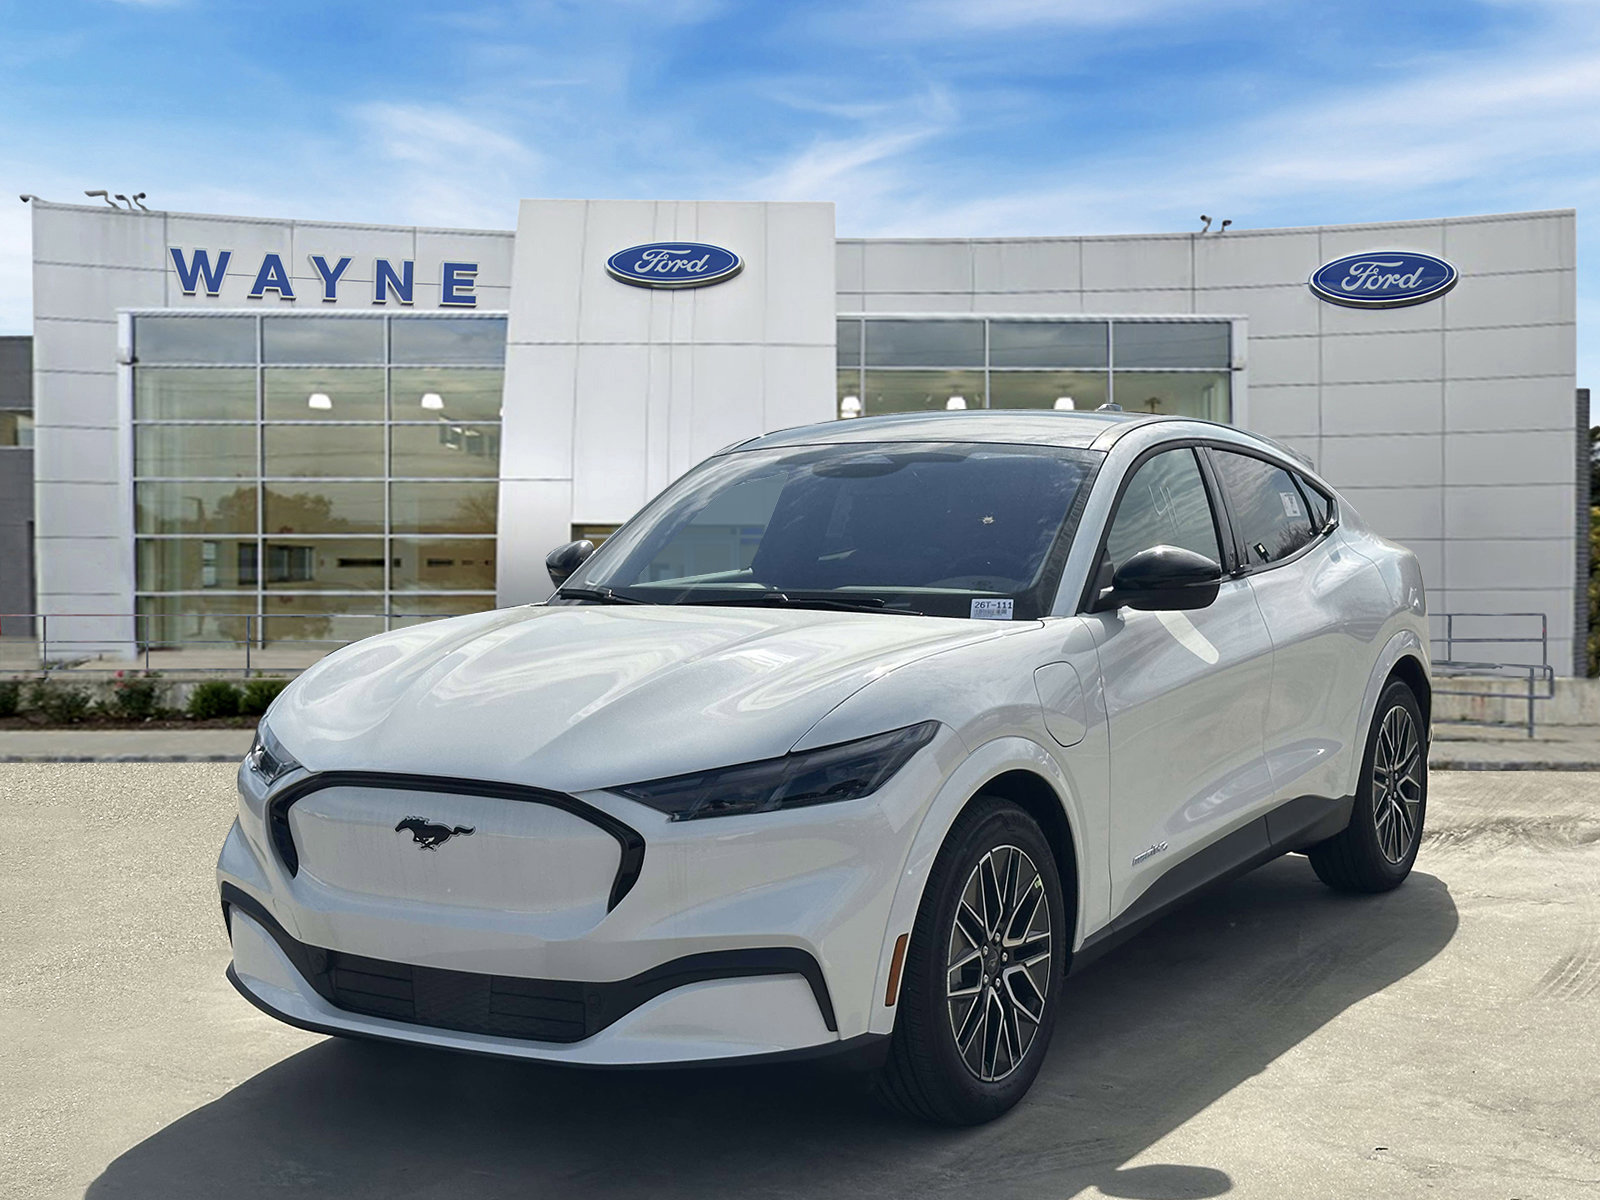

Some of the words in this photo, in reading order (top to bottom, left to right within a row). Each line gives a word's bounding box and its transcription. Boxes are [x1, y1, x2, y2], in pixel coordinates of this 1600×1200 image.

[634, 249, 710, 273] Ford
[168, 246, 480, 306] WAYNE
[1341, 261, 1424, 291] Ford
[974, 601, 1012, 609] 26T-111
